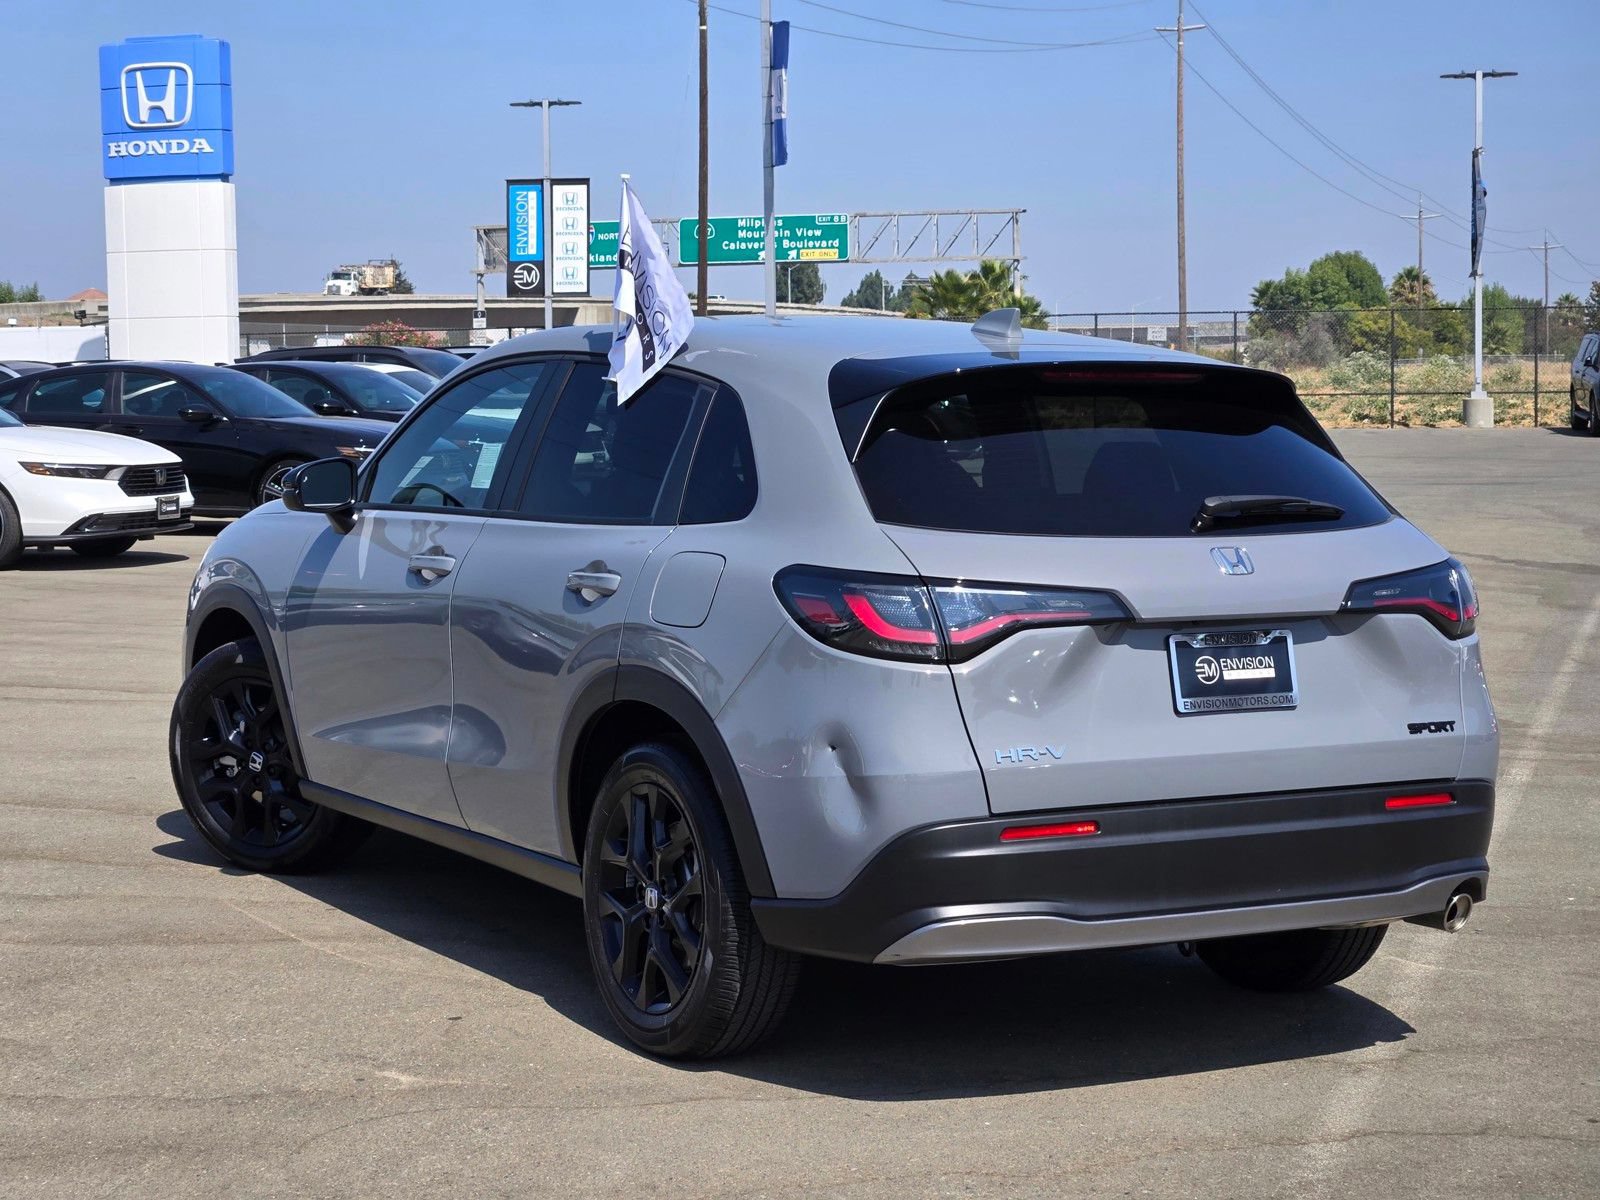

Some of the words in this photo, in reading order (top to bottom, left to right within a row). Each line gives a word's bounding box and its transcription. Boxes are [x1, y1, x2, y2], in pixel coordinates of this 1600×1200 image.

[108, 138, 214, 157] HONDA
[516, 191, 528, 255] ENVISION
[738, 218, 783, 228] Milpis
[738, 229, 790, 238] Mounain
[796, 228, 822, 237] View
[722, 241, 777, 250] Calaver
[782, 238, 839, 248] Boulevard
[1204, 632, 1257, 645] ENVISION
[1220, 656, 1274, 670] ENVISION
[1183, 694, 1294, 710] ENVISIONMOTORS.COM
[1407, 720, 1456, 734] SPORT
[994, 744, 1066, 764] HR-V
